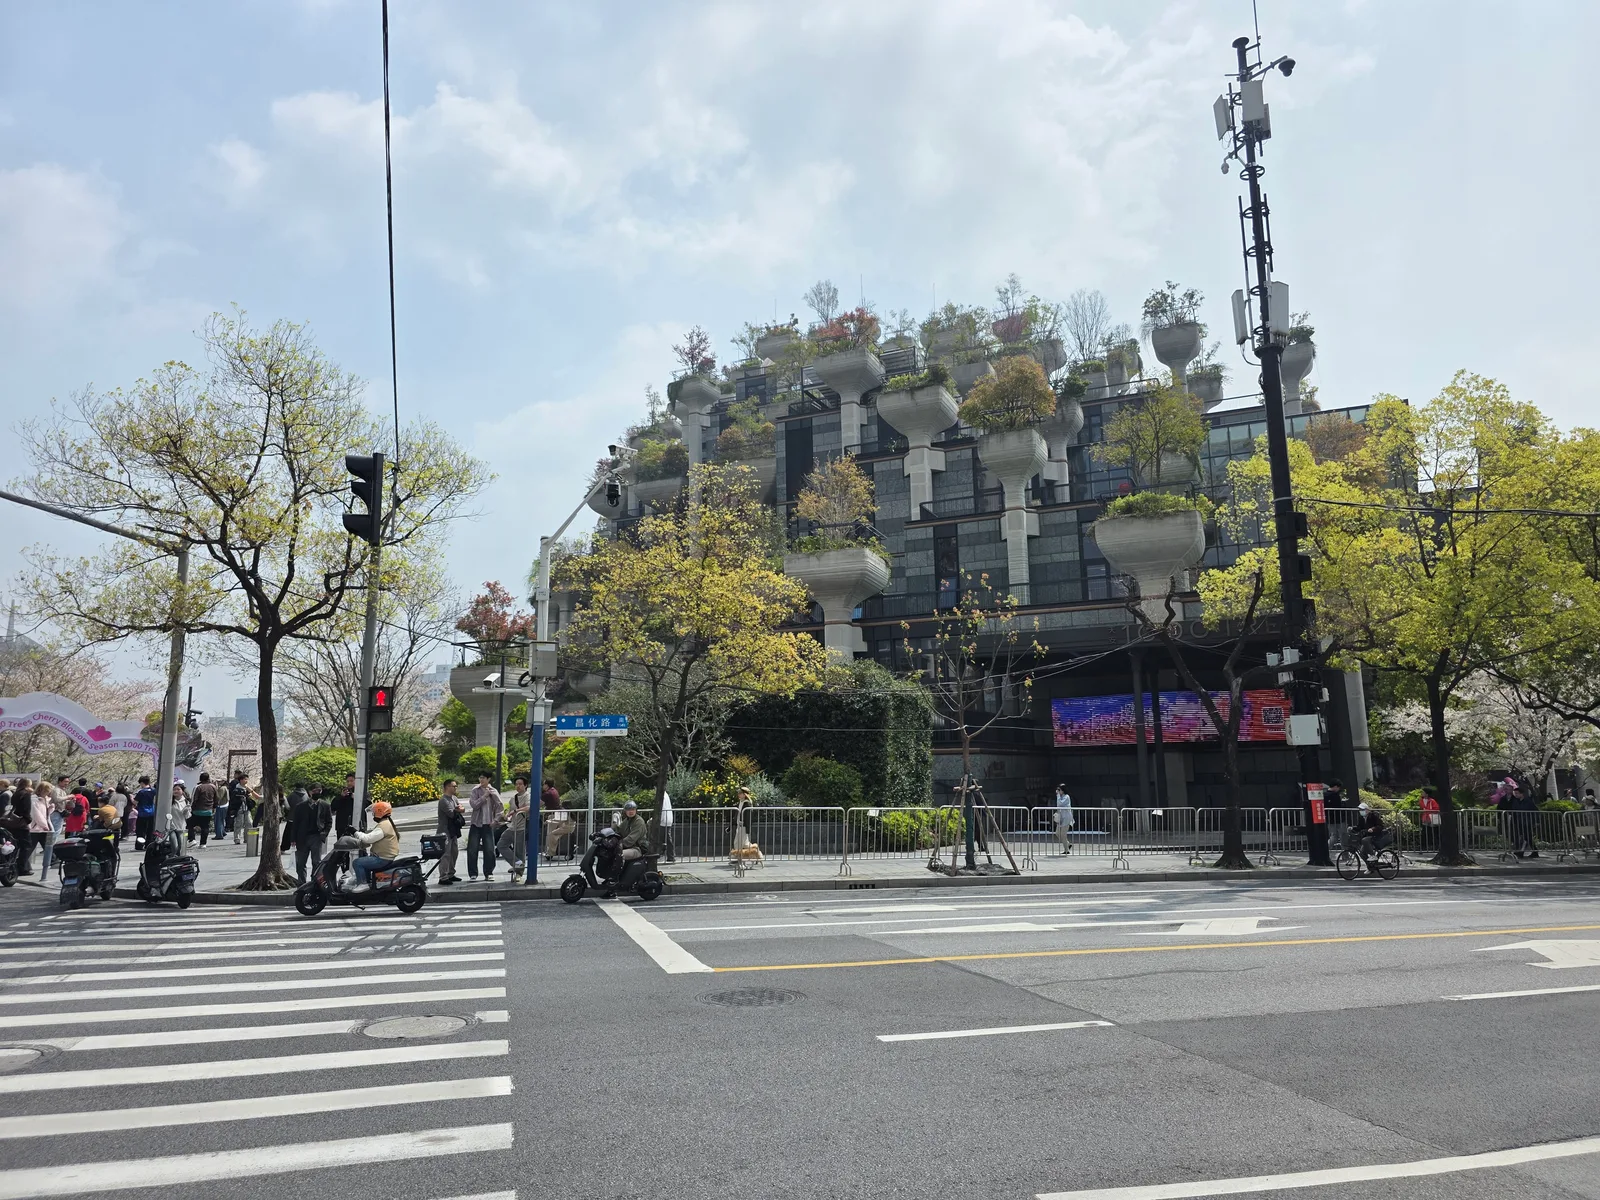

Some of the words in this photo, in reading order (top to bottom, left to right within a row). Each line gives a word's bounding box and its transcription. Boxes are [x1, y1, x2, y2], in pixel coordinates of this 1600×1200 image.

[8, 719, 33, 728] Trees
[32, 713, 61, 725] Cherry
[60, 720, 89, 745] Blossom
[88, 742, 119, 750] Season
[123, 741, 143, 750] 1000
[144, 744, 160, 758] Tree
[575, 717, 610, 727] 昌化路
